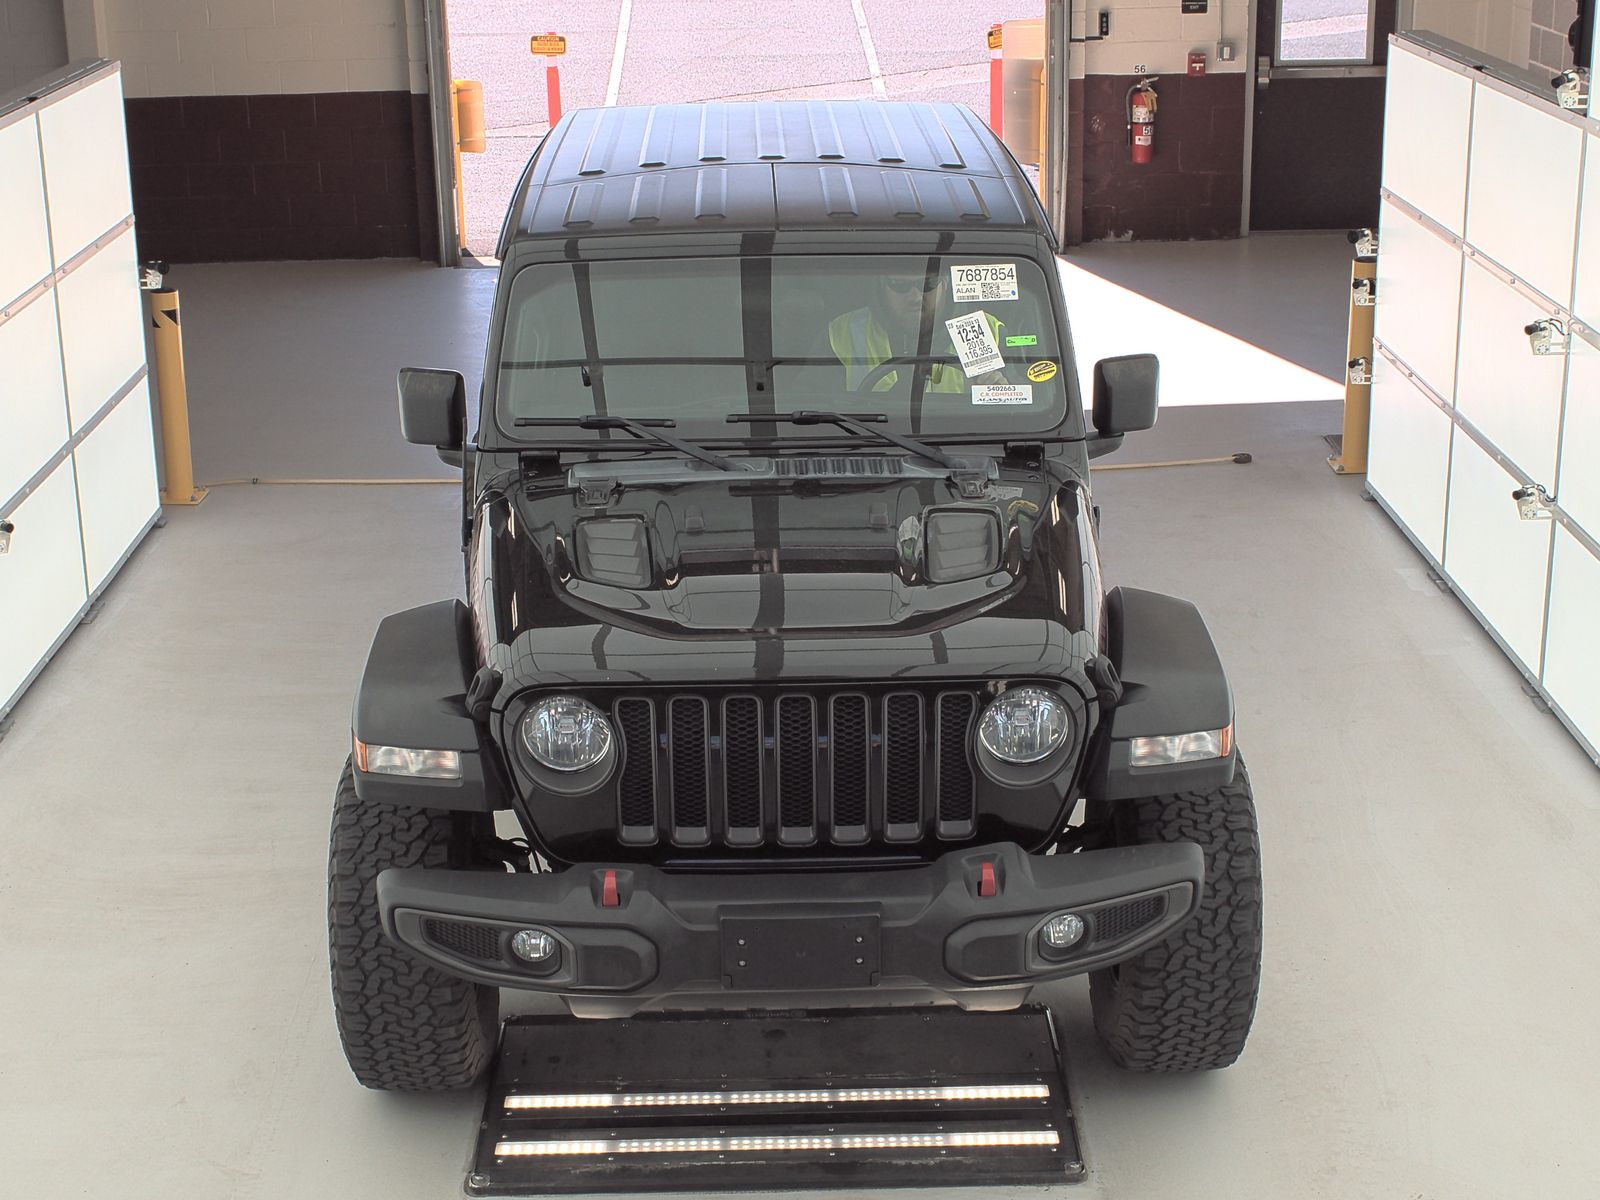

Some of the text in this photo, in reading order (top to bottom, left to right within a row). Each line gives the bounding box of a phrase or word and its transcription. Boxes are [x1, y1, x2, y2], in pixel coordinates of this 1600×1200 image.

[957, 268, 1015, 282] 7687854
[958, 324, 985, 343] 12:54
[967, 338, 985, 350] 2018
